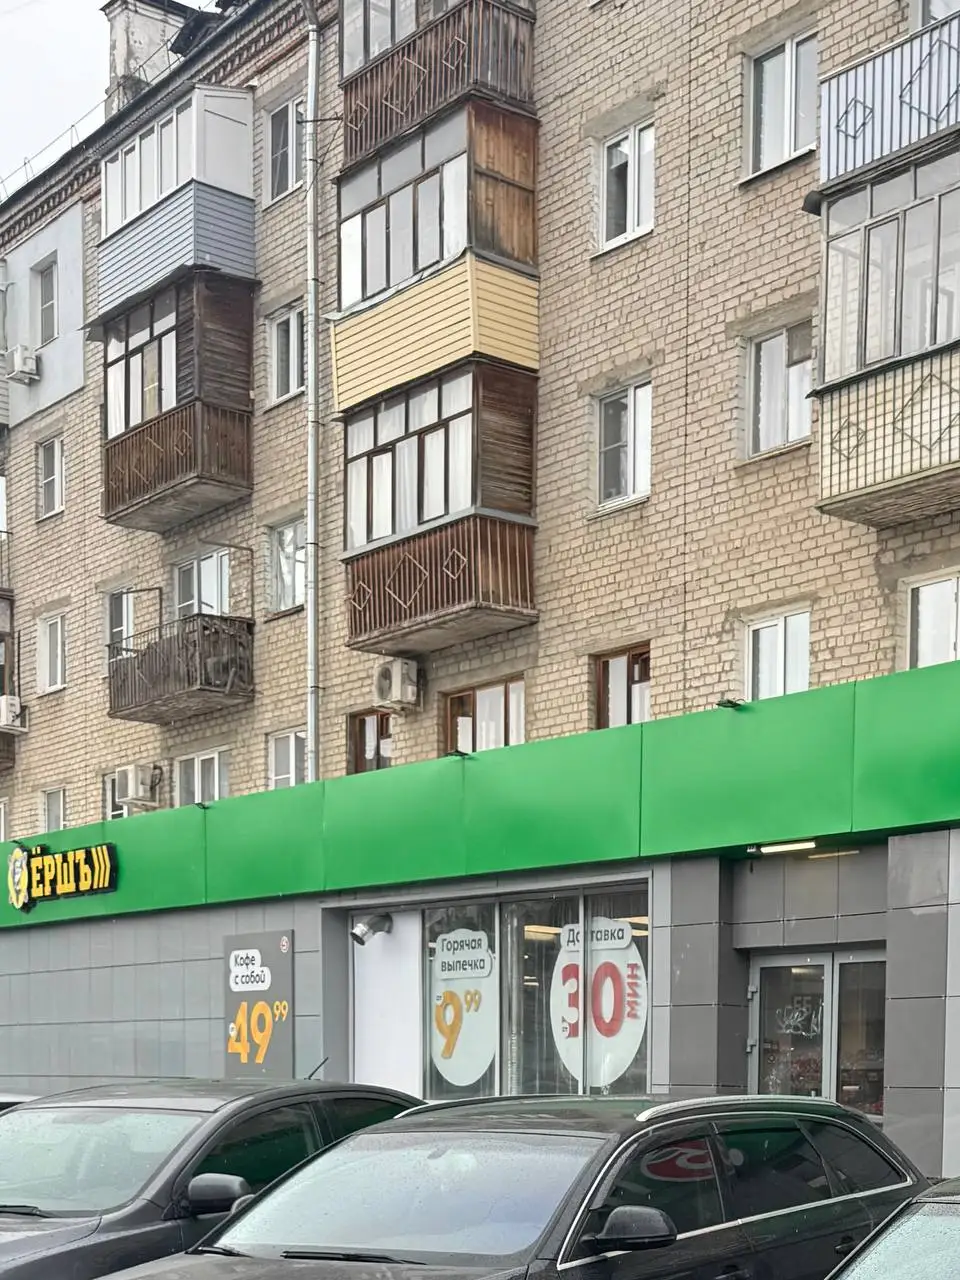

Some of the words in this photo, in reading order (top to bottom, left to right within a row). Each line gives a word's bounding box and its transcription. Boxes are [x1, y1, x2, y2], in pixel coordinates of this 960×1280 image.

[567, 928, 624, 946] Дотавка
[441, 938, 482, 955] Горячая
[234, 954, 256, 969] Кофе
[441, 958, 486, 972] выпечка
[234, 976, 239, 985] с
[240, 970, 266, 985] собой
[562, 961, 624, 1038] 30
[228, 1001, 273, 1064] 49
[273, 1000, 289, 1022] 99
[435, 990, 463, 1060] 9
[464, 989, 482, 1013] 99
